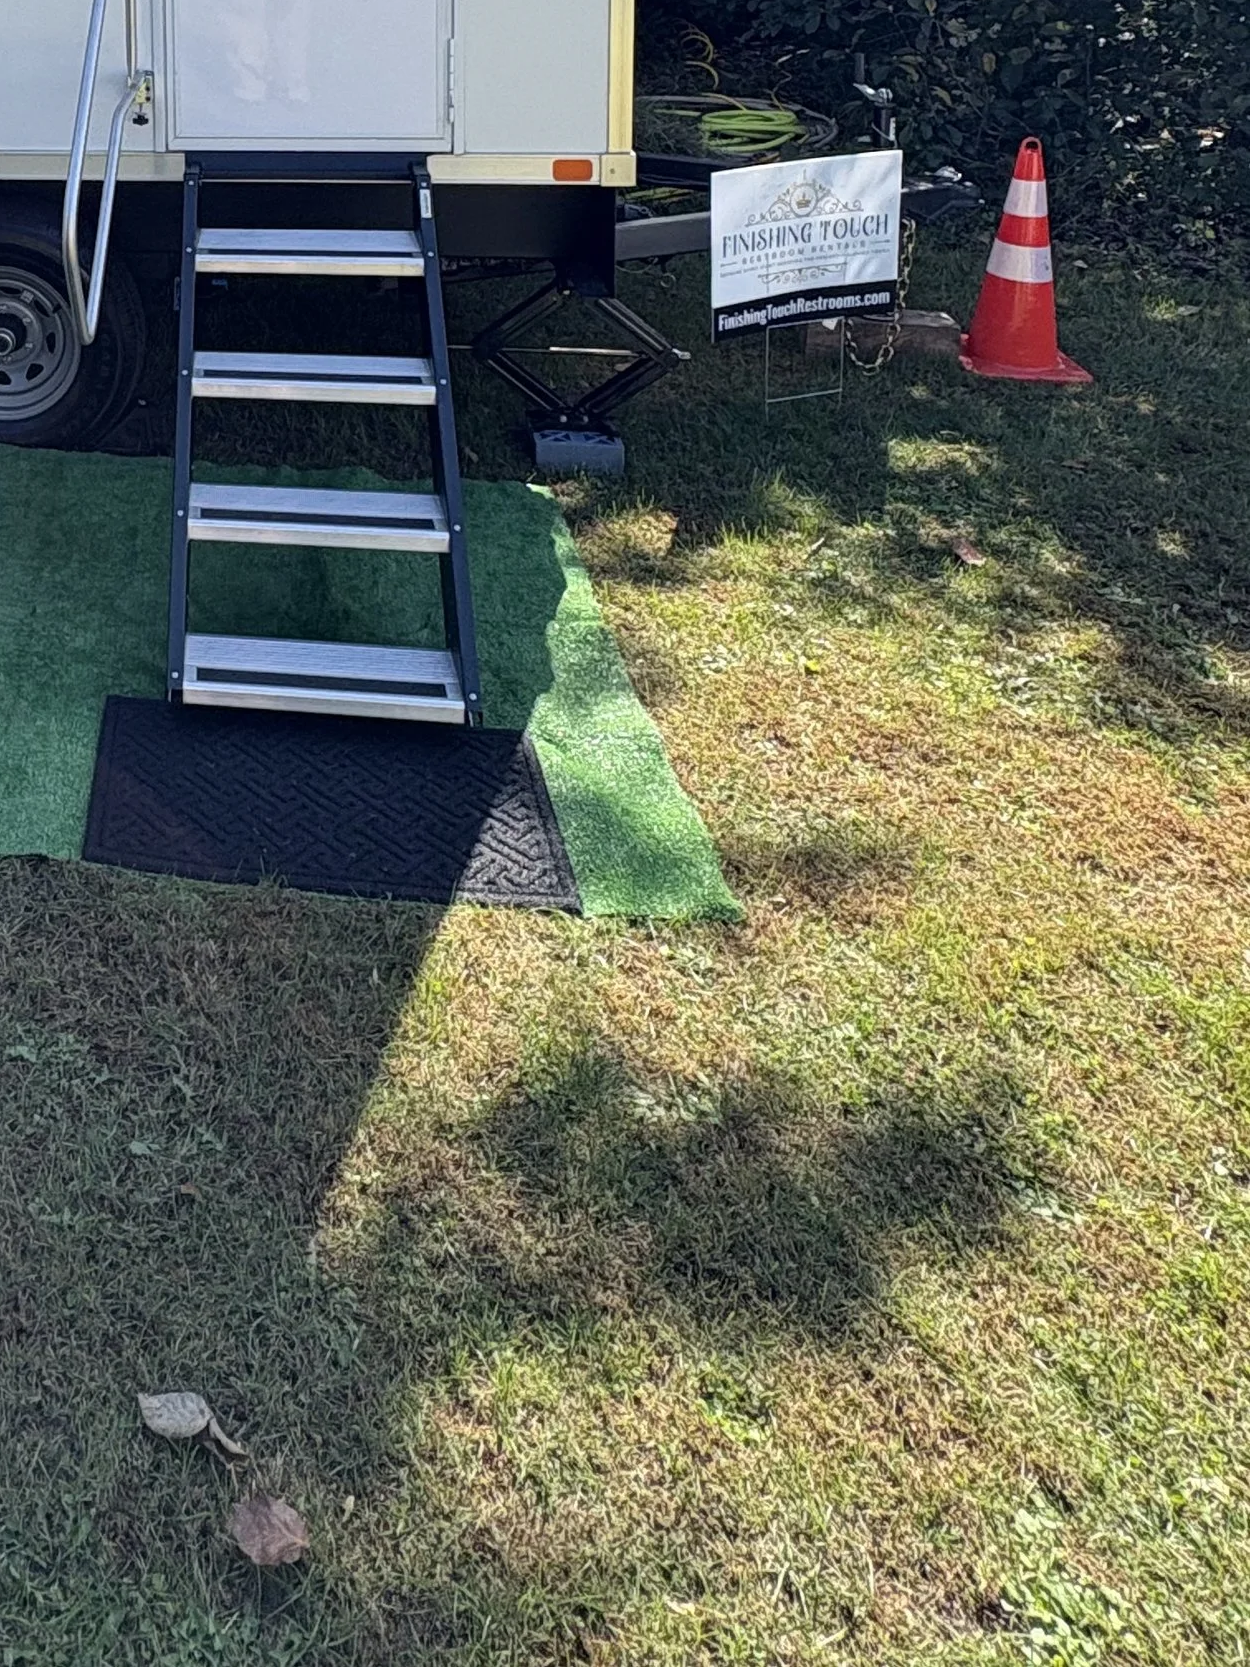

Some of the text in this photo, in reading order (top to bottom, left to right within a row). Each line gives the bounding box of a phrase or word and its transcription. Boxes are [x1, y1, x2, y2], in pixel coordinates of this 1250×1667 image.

[722, 213, 888, 259] FINISHING TOUCH
[718, 291, 890, 331] FinishingTouchRestrooms.com
